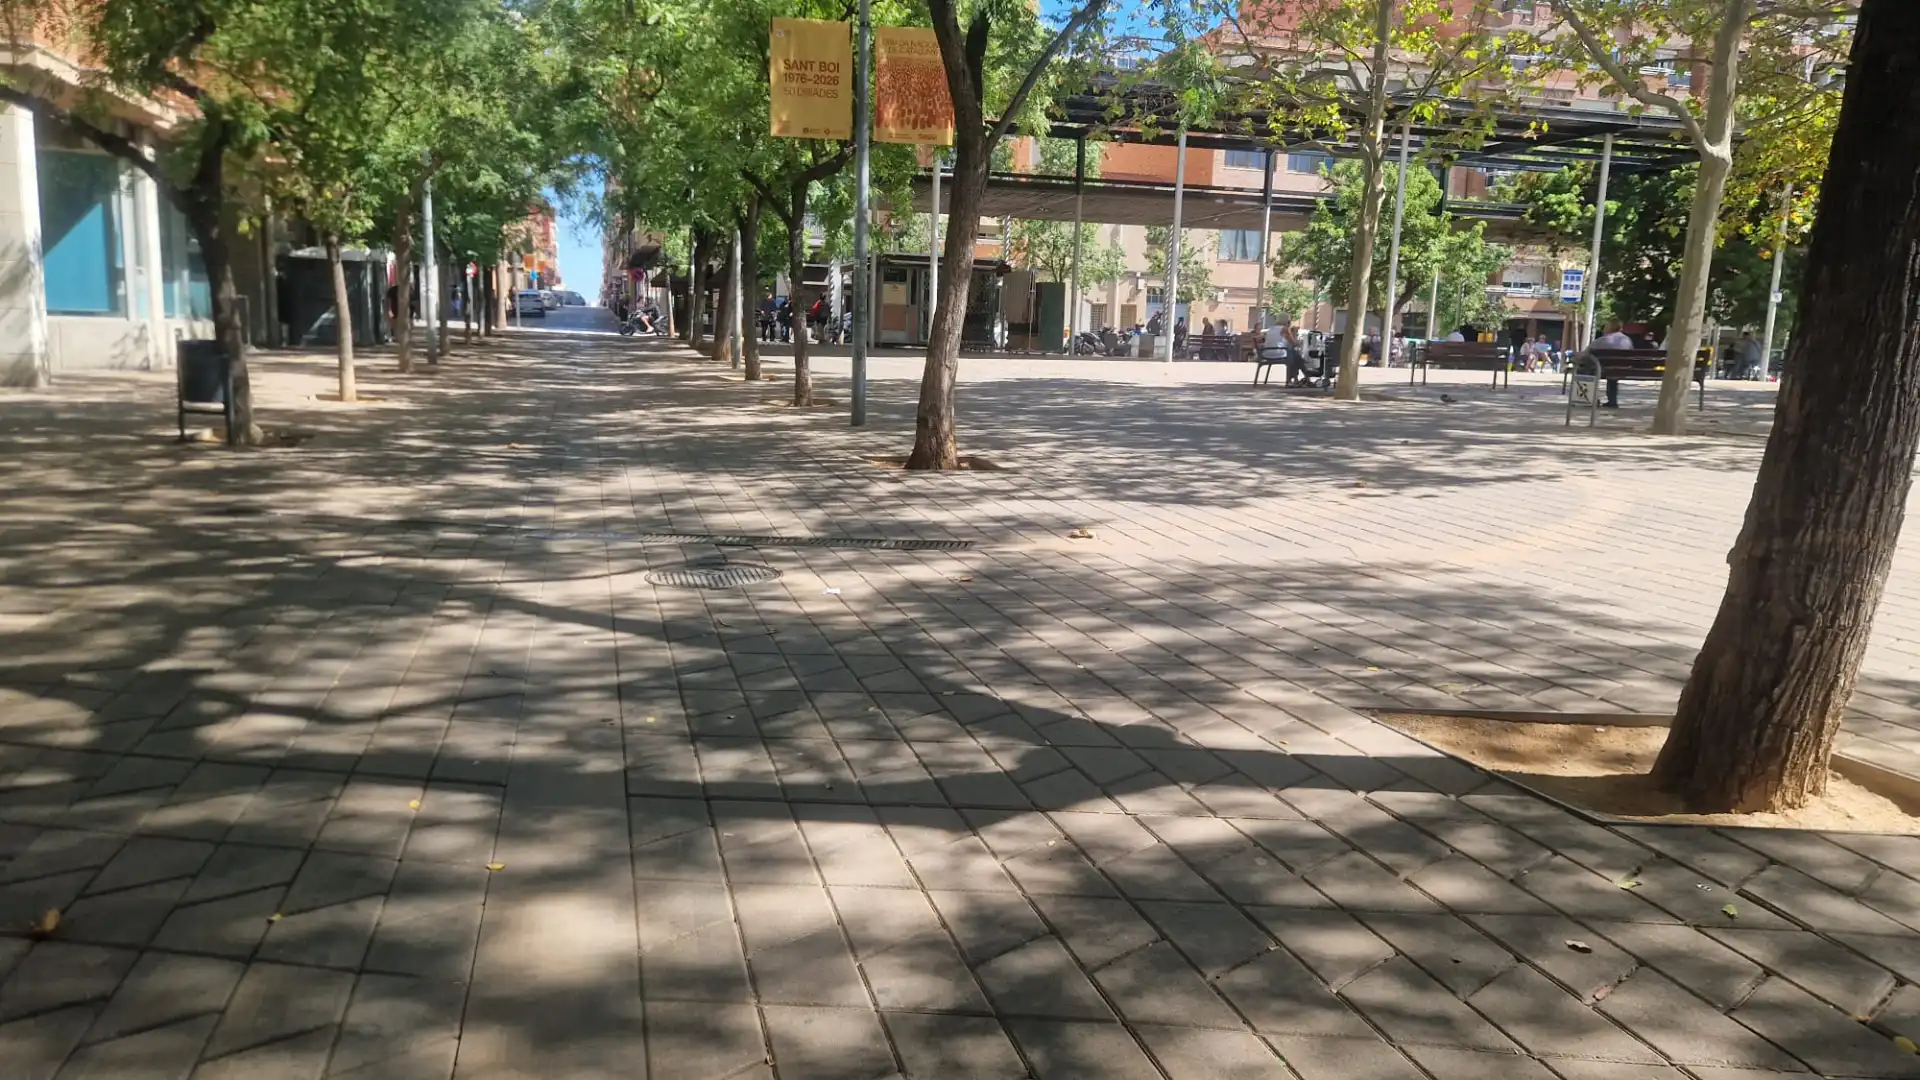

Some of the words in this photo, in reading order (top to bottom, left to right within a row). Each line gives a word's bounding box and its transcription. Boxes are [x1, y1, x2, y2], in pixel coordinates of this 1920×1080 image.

[783, 58, 815, 72] SANT
[819, 61, 840, 73] BOI
[783, 86, 796, 96] 50
